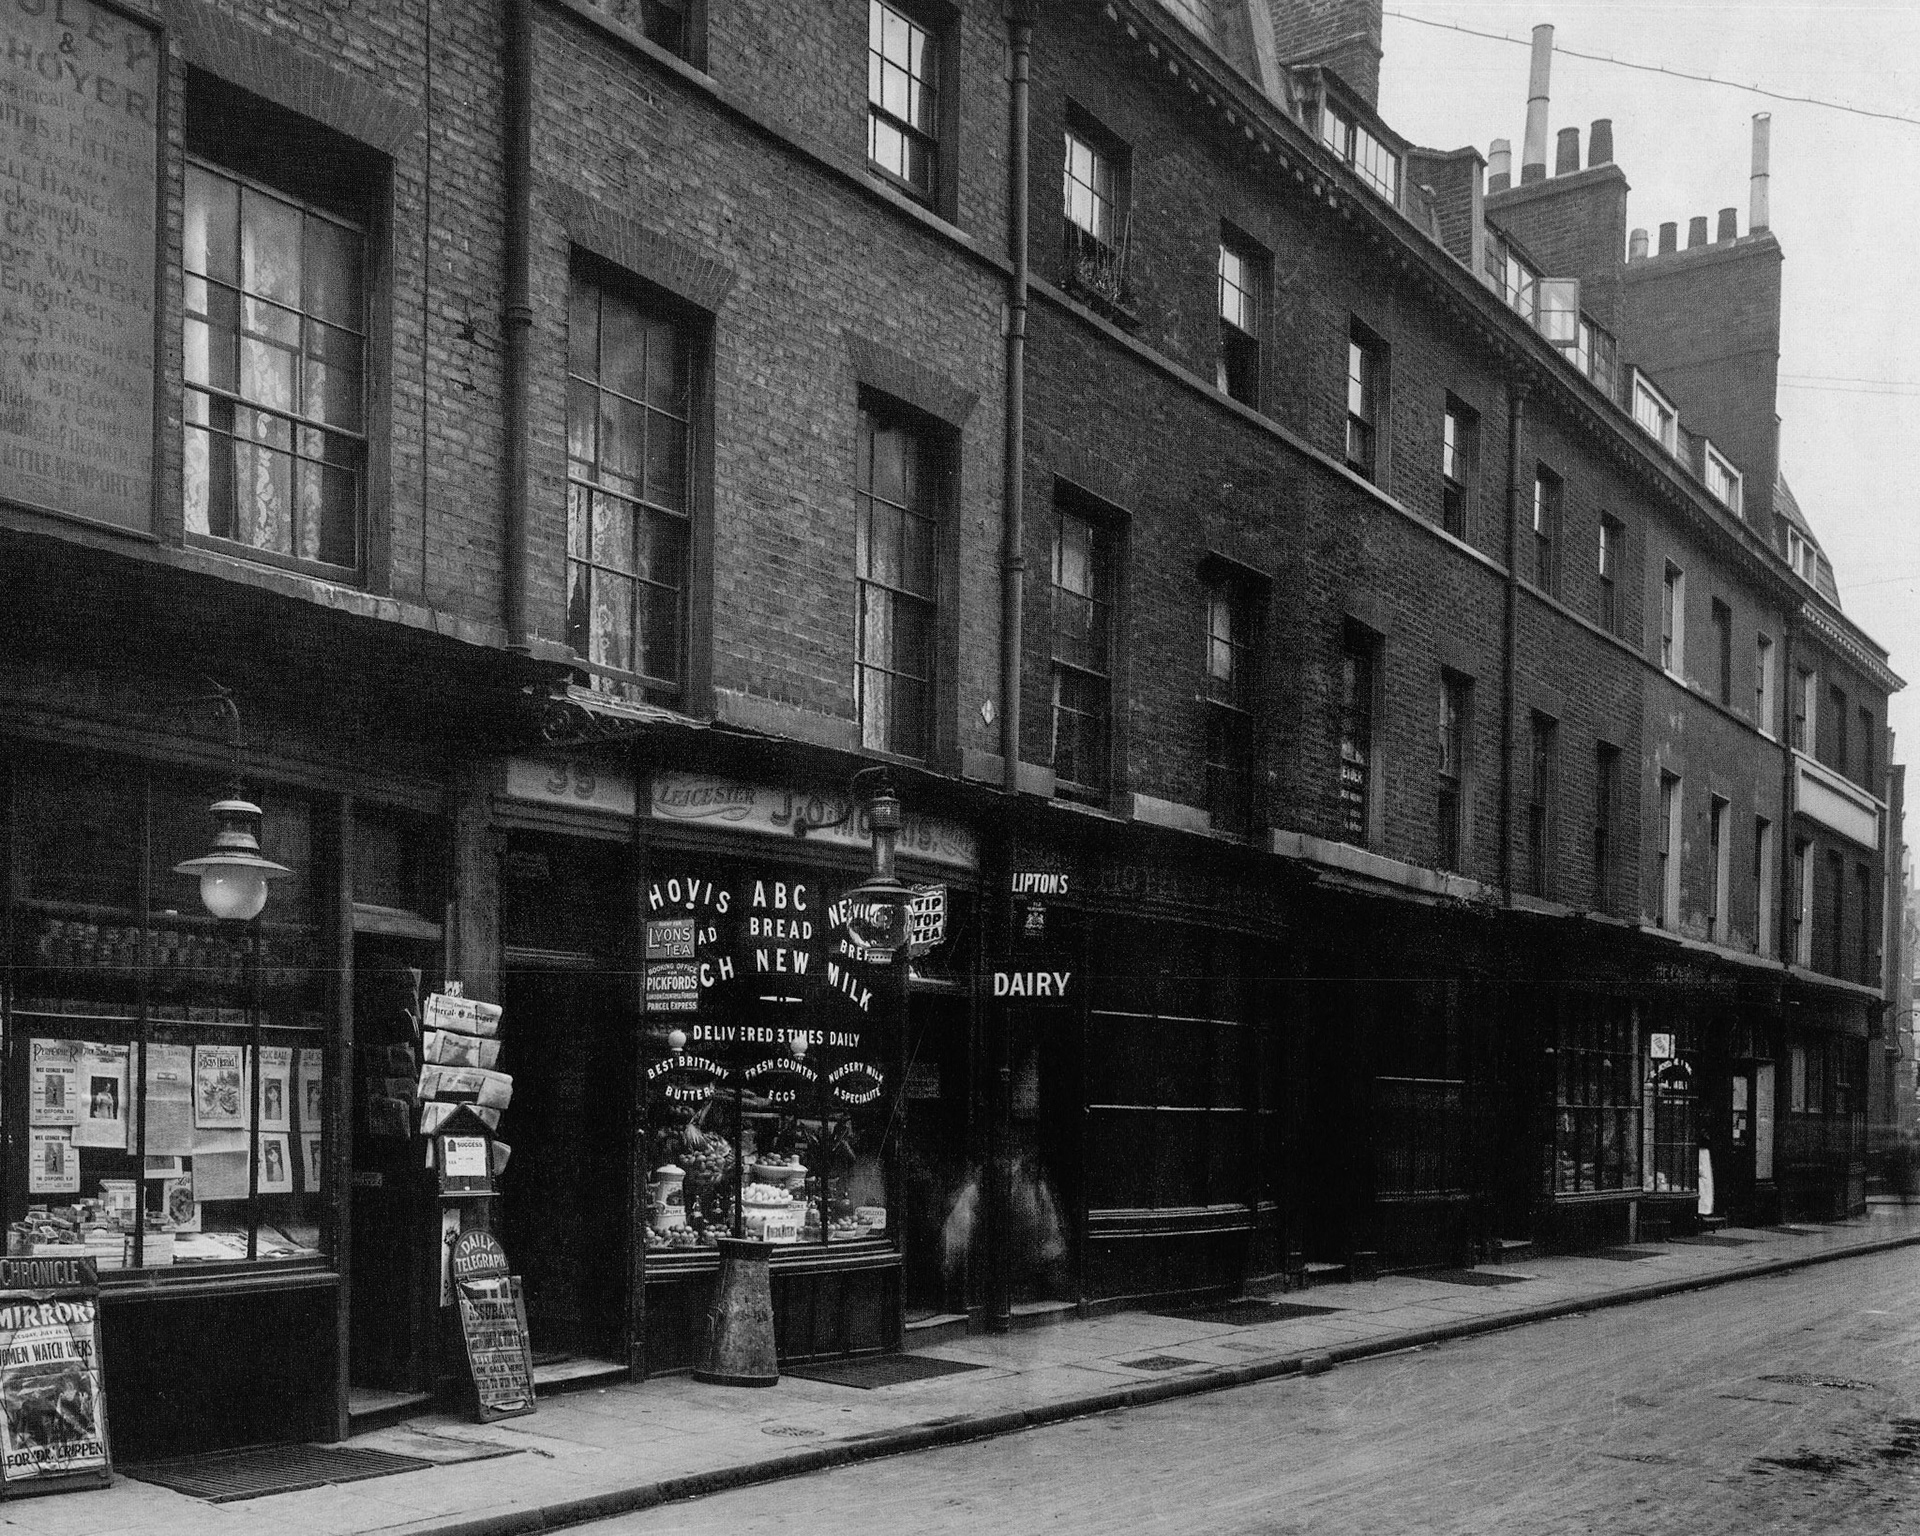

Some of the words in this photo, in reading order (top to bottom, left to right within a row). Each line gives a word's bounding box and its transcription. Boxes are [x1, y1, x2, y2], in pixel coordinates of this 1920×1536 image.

[59, 31, 82, 61] &
[0, 184, 99, 238] cksmiths
[4, 209, 48, 246] GAS
[0, 241, 36, 270] OT
[1, 263, 123, 328] Engineers
[2, 306, 43, 335] ASS
[752, 879, 807, 911] ABC
[1011, 872, 1069, 895] LIPTONS
[649, 877, 731, 914] HOVIS
[913, 896, 942, 912] TIP
[750, 916, 812, 941] BREAD
[914, 912, 942, 927] TOP
[698, 927, 718, 946] AD
[912, 927, 940, 942] TEA
[664, 943, 692, 956] TEA
[840, 939, 870, 961] BRE
[648, 963, 674, 976] BOOKING
[676, 963, 698, 975] OFFICE
[700, 956, 735, 988] CH
[756, 949, 810, 975] NEW
[827, 961, 875, 1013] MILK
[647, 976, 698, 991] PICKFORDS
[993, 971, 1071, 998] DAIRY
[647, 1002, 669, 1010] PARCEL
[670, 1001, 697, 1010] EXPRESS
[693, 1025, 774, 1043] DELIVERED
[777, 1029, 786, 1043] 3
[829, 1031, 861, 1048] DAILY
[648, 1058, 674, 1080] BEST
[678, 1056, 730, 1080] BRITTANY
[745, 1058, 774, 1080] FRESH
[776, 1058, 819, 1082] COUNTRY
[828, 1061, 864, 1084] NURSERY
[866, 1065, 884, 1084] MILK
[665, 1085, 711, 1101] BUTTER
[834, 1086, 840, 1096] A
[456, 1141, 484, 1149] SUCCESS
[460, 1233, 496, 1256] DAILY
[0, 1259, 81, 1287] CHRONICLE
[455, 1253, 508, 1272] TELEGRAPH
[32, 1342, 65, 1360] WATCH
[66, 1339, 93, 1358] LINERS
[7, 1452, 31, 1469] FOR
[57, 1441, 104, 1459] CRIPPEN
